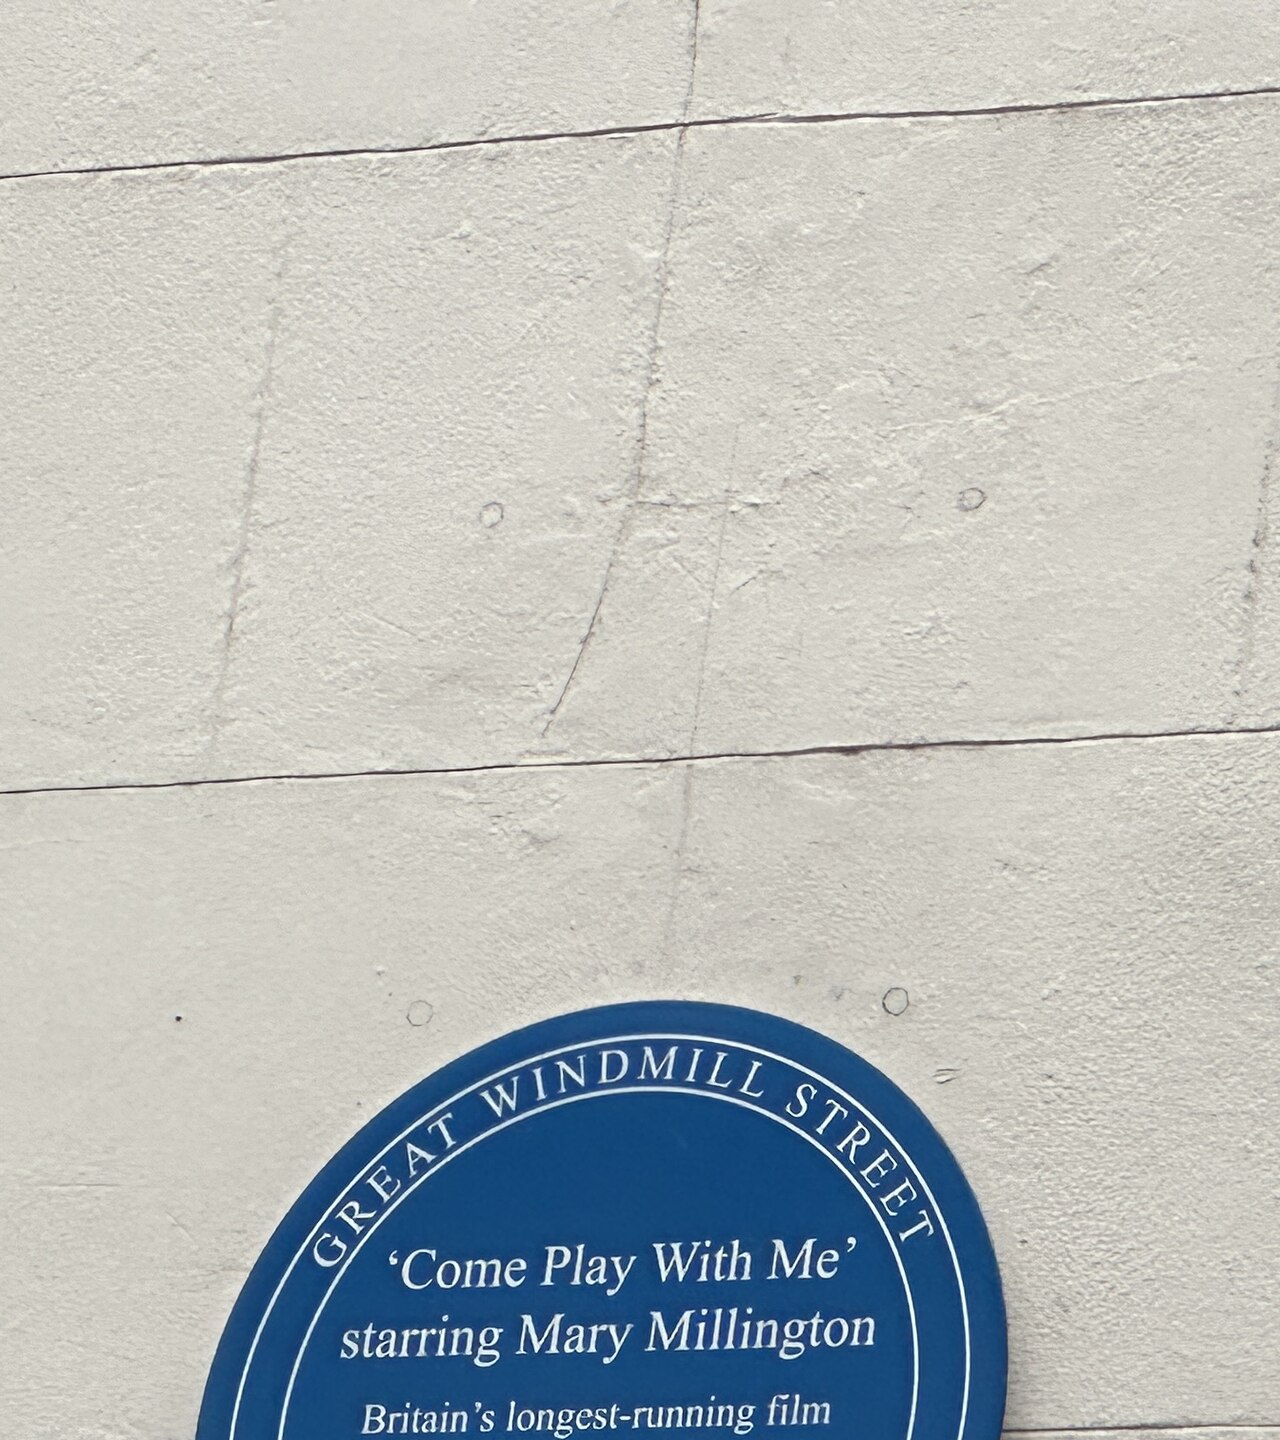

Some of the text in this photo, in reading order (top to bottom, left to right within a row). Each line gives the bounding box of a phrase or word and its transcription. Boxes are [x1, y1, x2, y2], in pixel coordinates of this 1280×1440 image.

[314, 1046, 934, 1267] GREAT WINDMILL STREET
[389, 1237, 856, 1296] ‘Come Play With Me’
[341, 1308, 874, 1367] starring Mary Millington
[362, 1394, 830, 1439] Britain’s longest-running film
